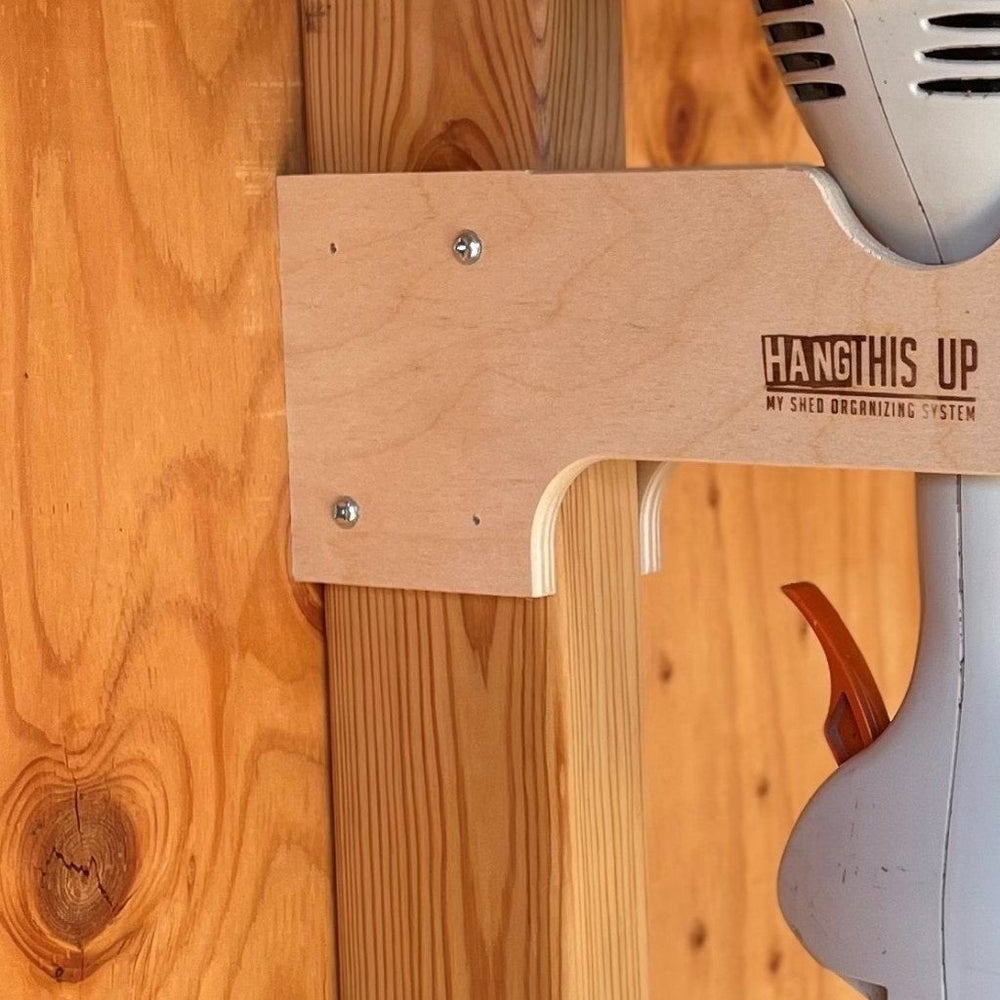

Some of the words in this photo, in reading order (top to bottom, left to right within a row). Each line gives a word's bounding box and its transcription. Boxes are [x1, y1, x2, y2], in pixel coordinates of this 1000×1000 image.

[937, 337, 979, 391] UP
[766, 395, 783, 412] MY
[790, 396, 825, 414] SHED
[830, 398, 916, 419] ORGANIZING
[921, 403, 977, 422] SYSTEM
